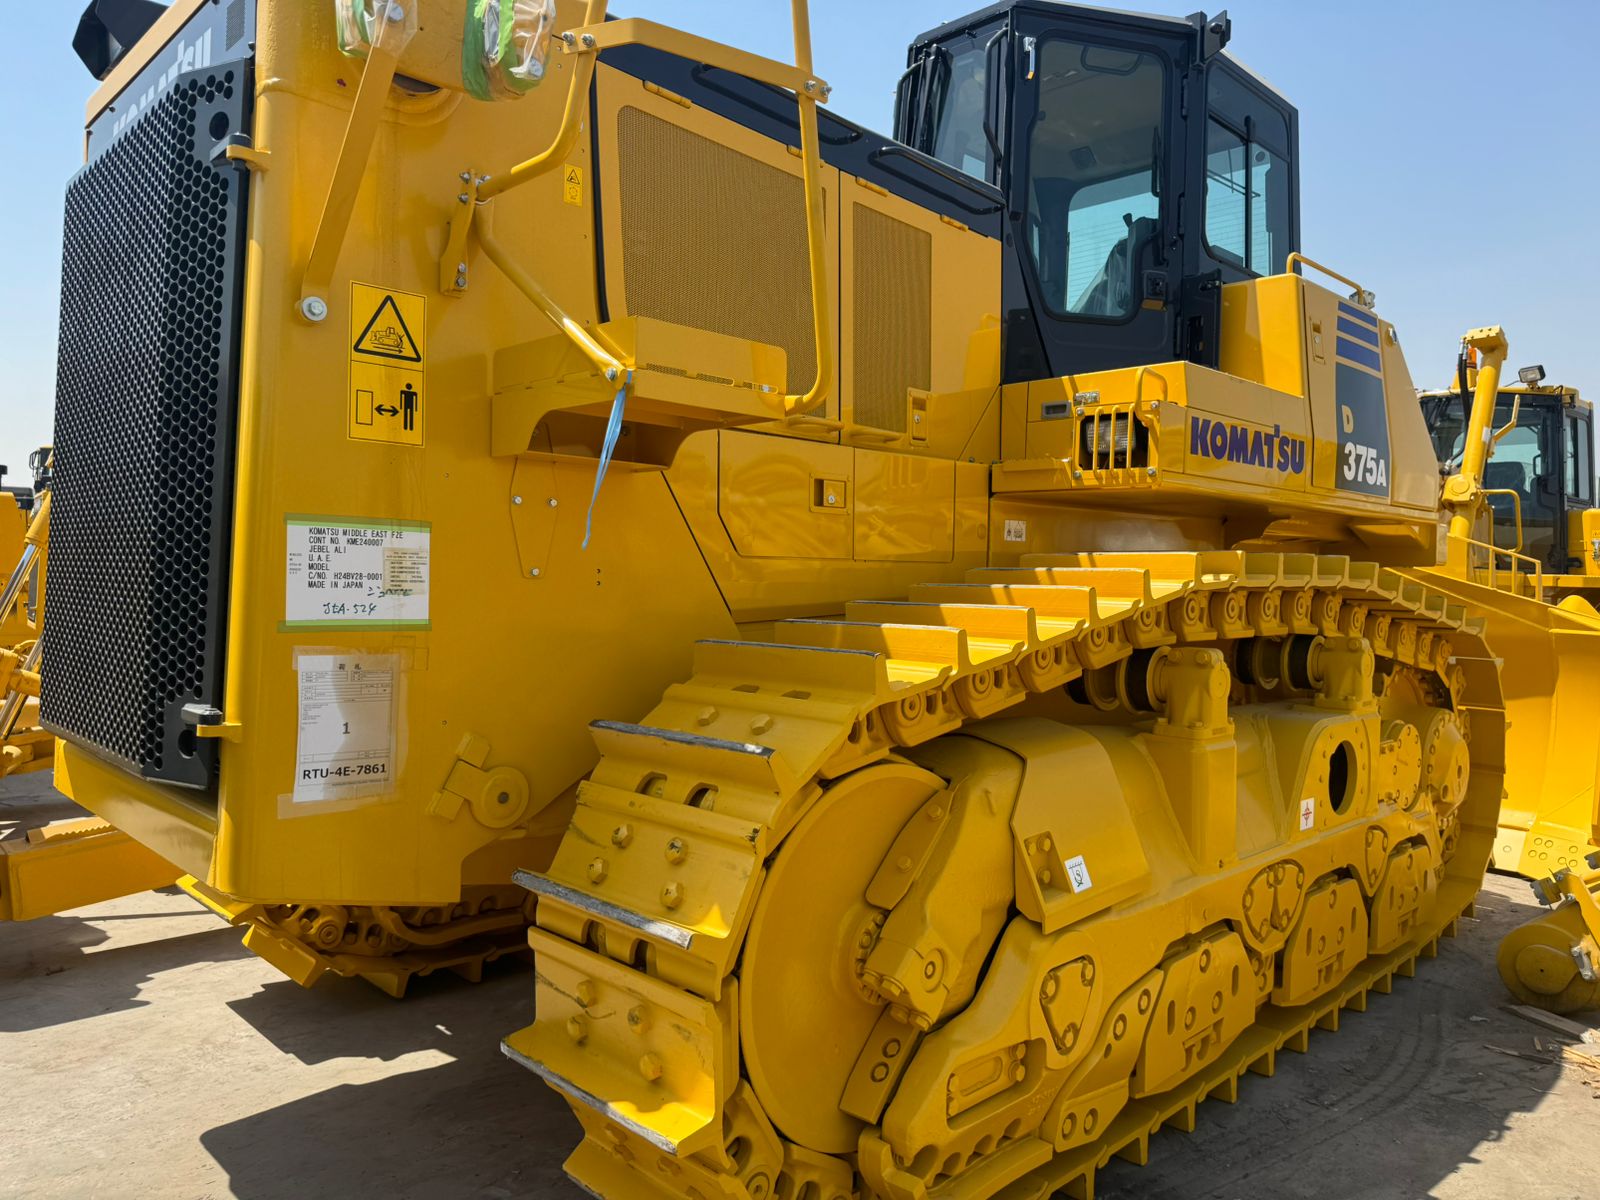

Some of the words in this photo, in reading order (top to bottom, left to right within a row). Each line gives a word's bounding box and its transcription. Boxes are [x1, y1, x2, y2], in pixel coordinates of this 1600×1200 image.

[1341, 405, 1354, 433] D
[1190, 416, 1305, 475] KOMATSU
[1343, 442, 1387, 488] 375A
[308, 526, 340, 536] KOMATSU
[342, 528, 368, 538] MIDDLE
[371, 530, 388, 539] EAST
[391, 531, 404, 539] FZE
[308, 535, 326, 545] CONT
[330, 536, 341, 545] NO.
[346, 537, 384, 547] KME240007
[308, 544, 330, 553] JEBEL
[334, 545, 347, 554] ALI
[308, 562, 330, 571] MODEL
[308, 571, 327, 580] C/NO.
[308, 580, 326, 589] MADE
[330, 580, 339, 589] IN
[342, 581, 364, 589] JAPAN
[342, 721, 351, 735] 1
[302, 763, 387, 780] RTU-4E-7861
